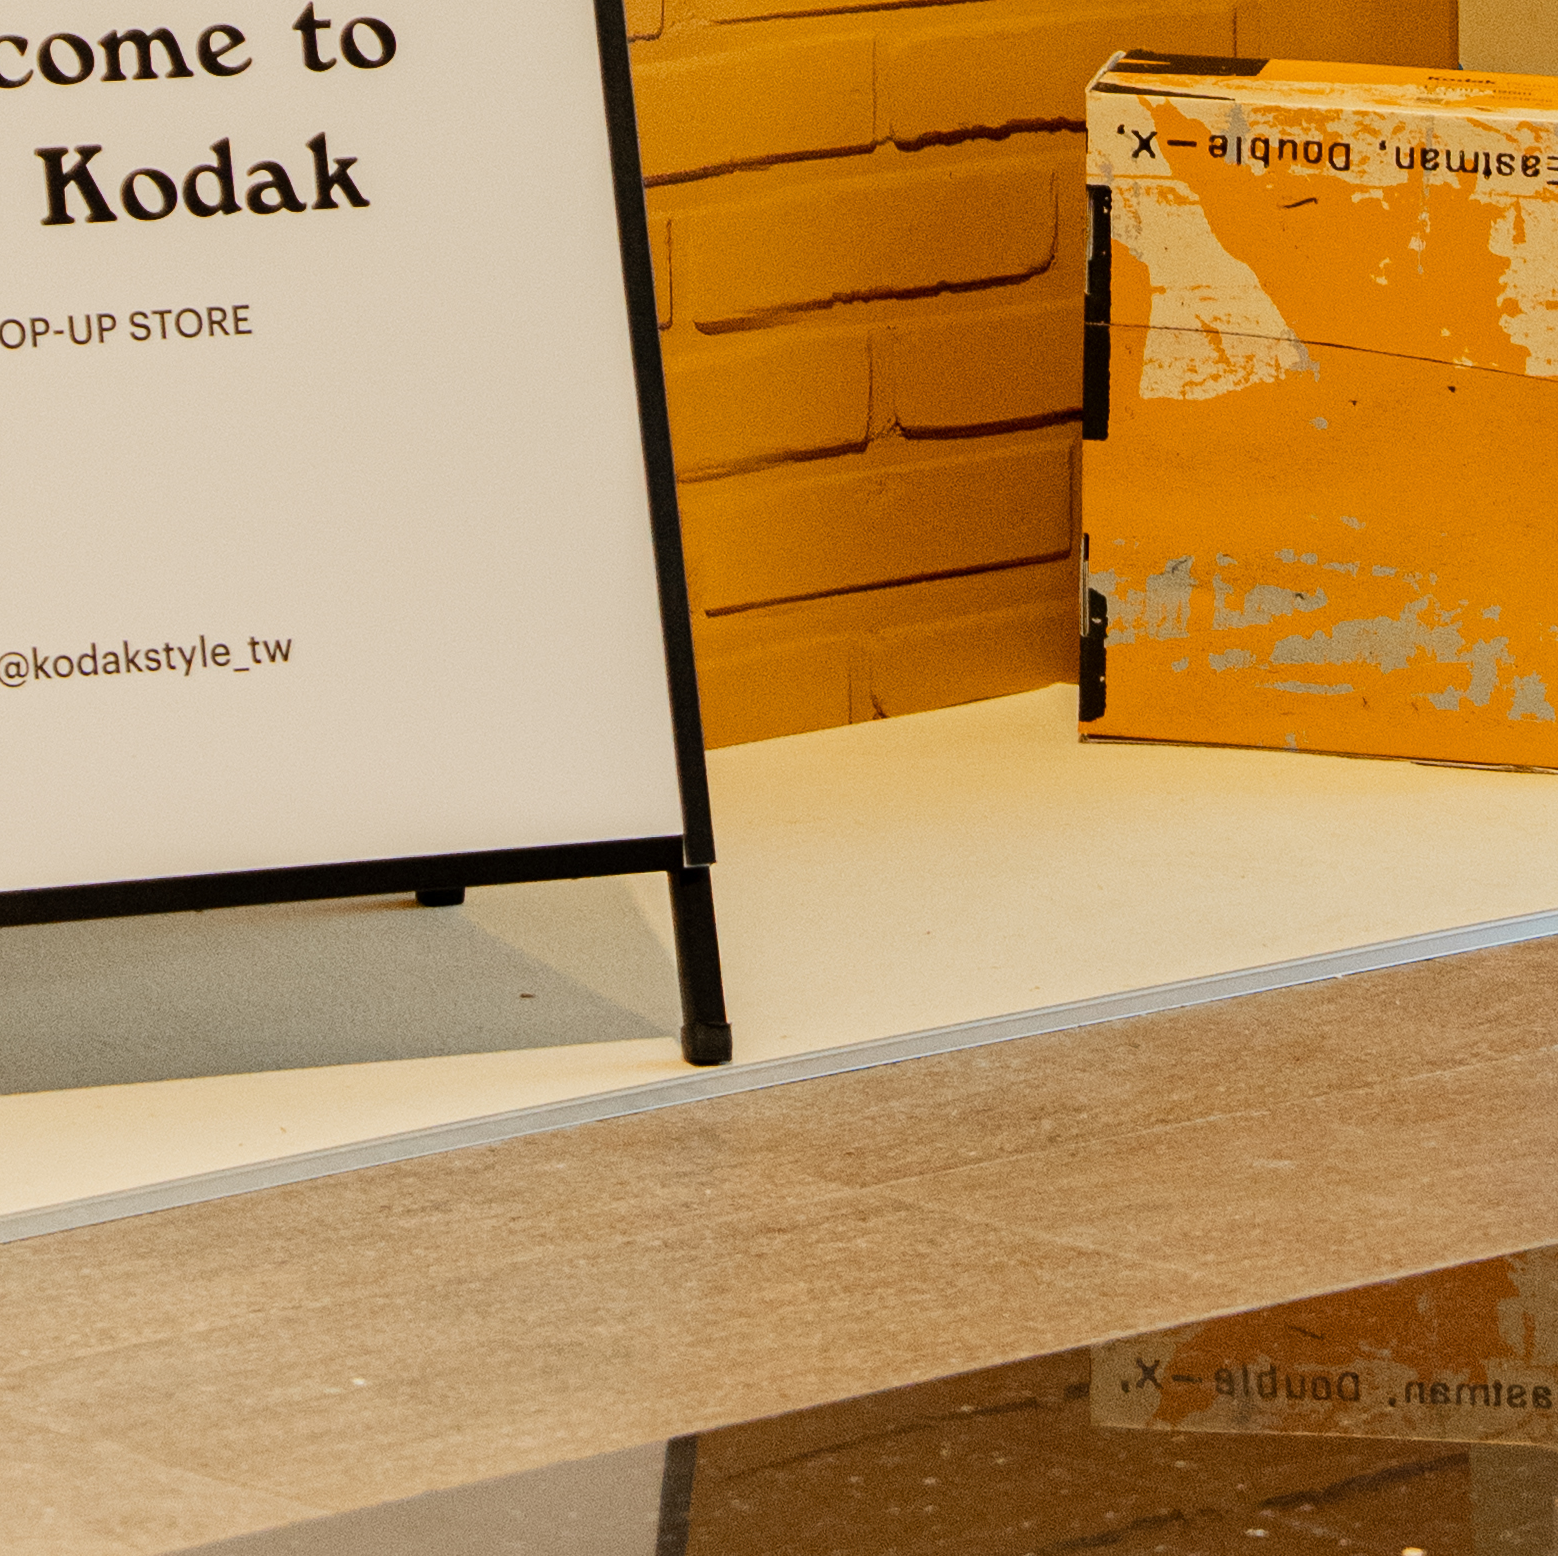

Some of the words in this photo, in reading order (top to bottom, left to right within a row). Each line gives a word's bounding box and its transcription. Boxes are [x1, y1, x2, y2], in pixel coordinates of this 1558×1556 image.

[291, 0, 399, 73] to
[33, 131, 372, 227] Kodak
[128, 304, 254, 342] STORE
